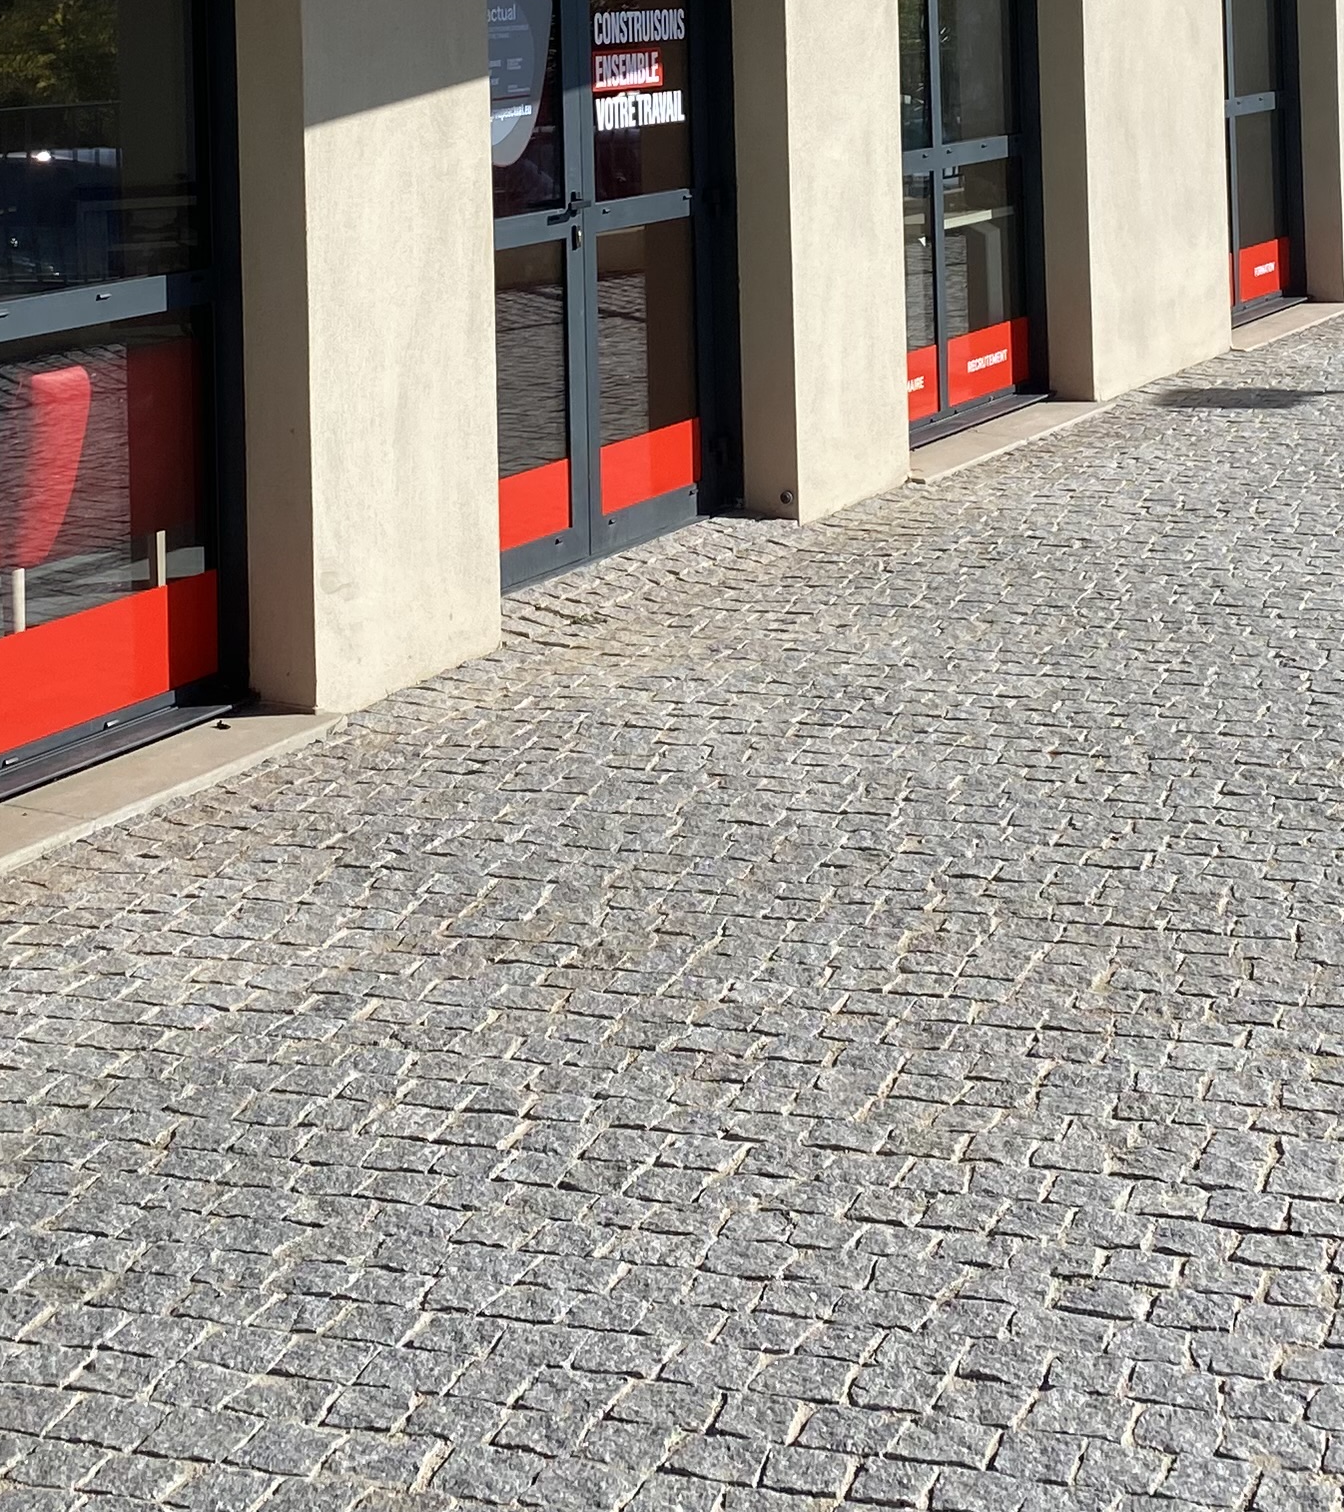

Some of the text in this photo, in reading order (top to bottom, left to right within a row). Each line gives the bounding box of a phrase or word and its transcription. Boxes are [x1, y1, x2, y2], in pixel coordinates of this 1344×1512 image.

[594, 8, 685, 45] CONSTRUISONS
[595, 51, 660, 88] ENSEMBLE
[595, 90, 686, 131] VOTRE TRAVAIL
[967, 348, 1008, 373] RECRUTEMENT
